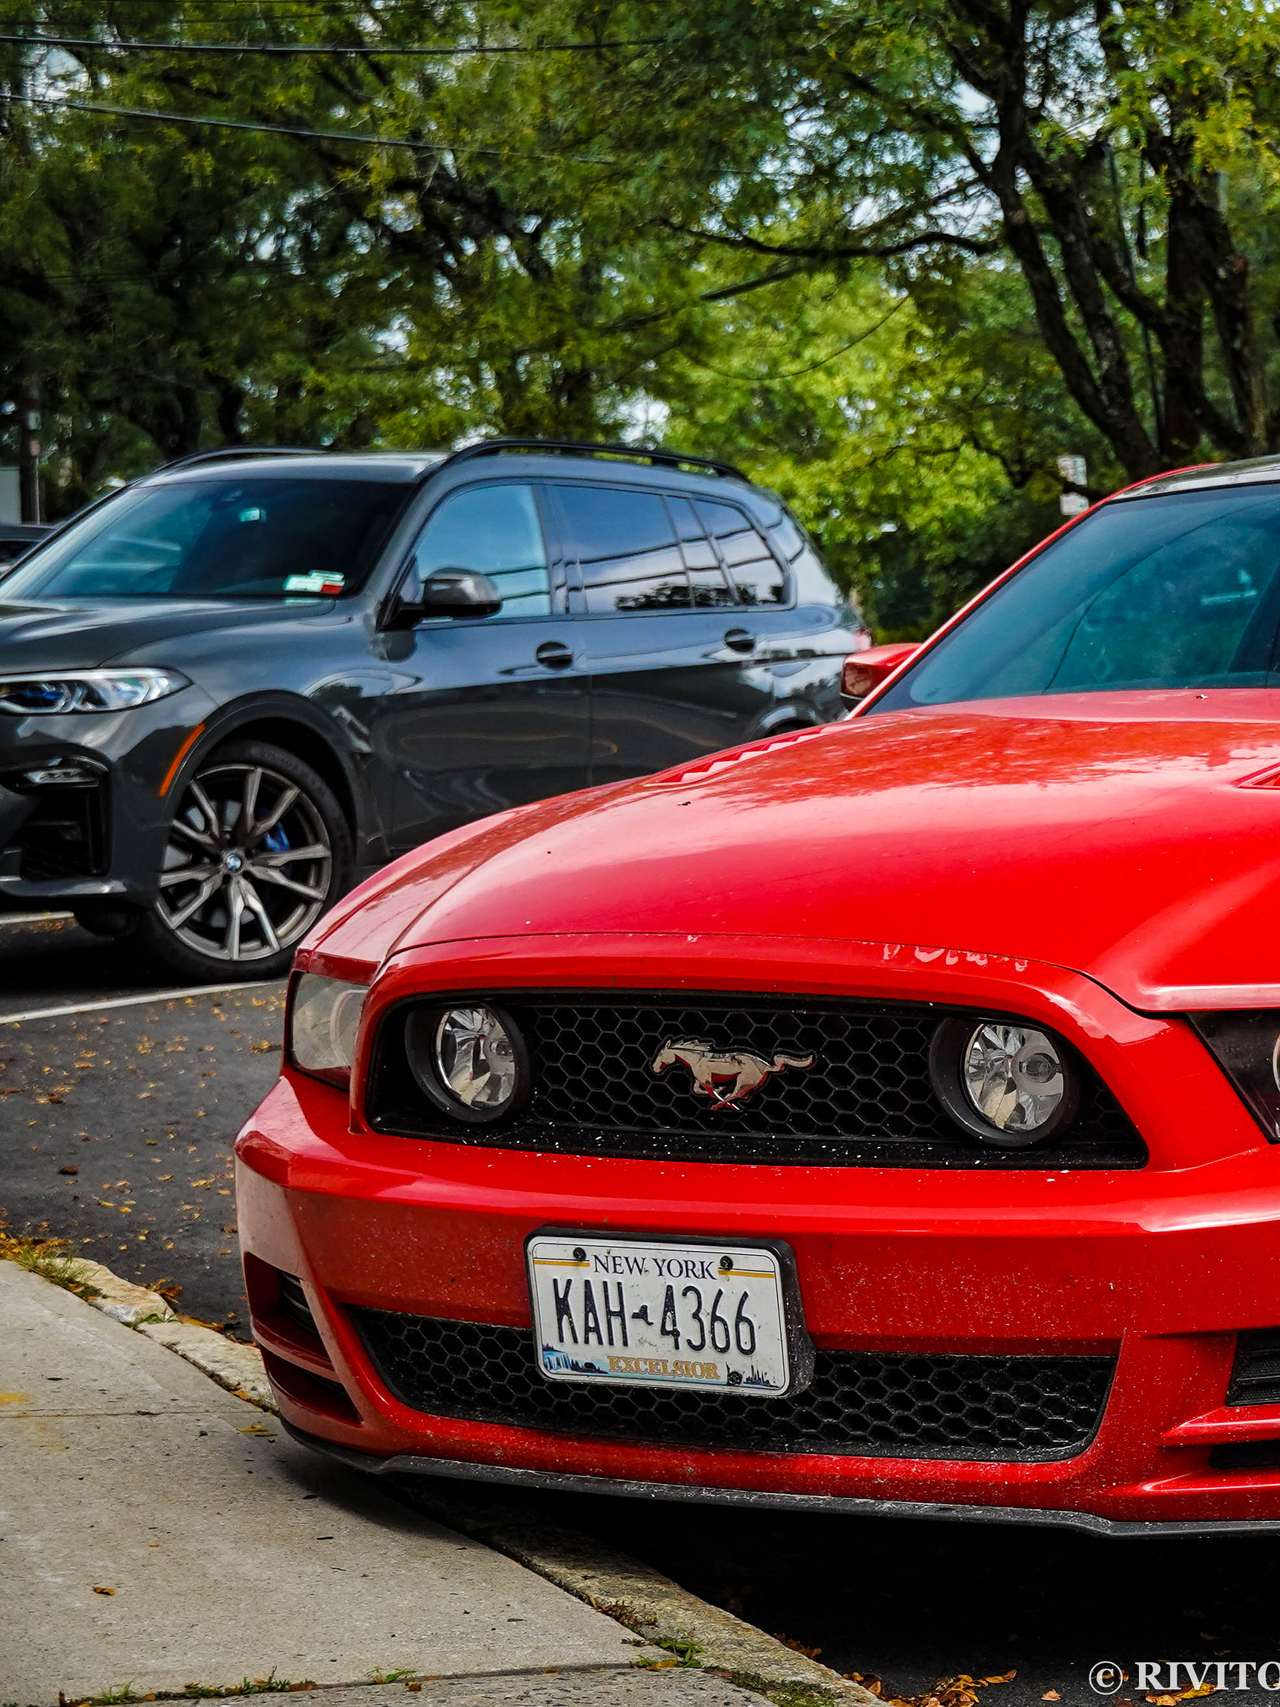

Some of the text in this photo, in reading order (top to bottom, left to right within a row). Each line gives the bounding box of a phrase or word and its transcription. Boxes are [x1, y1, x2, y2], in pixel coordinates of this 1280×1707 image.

[592, 1254, 718, 1280] NEW YORK
[606, 1355, 721, 1380] EXCELSIOR
